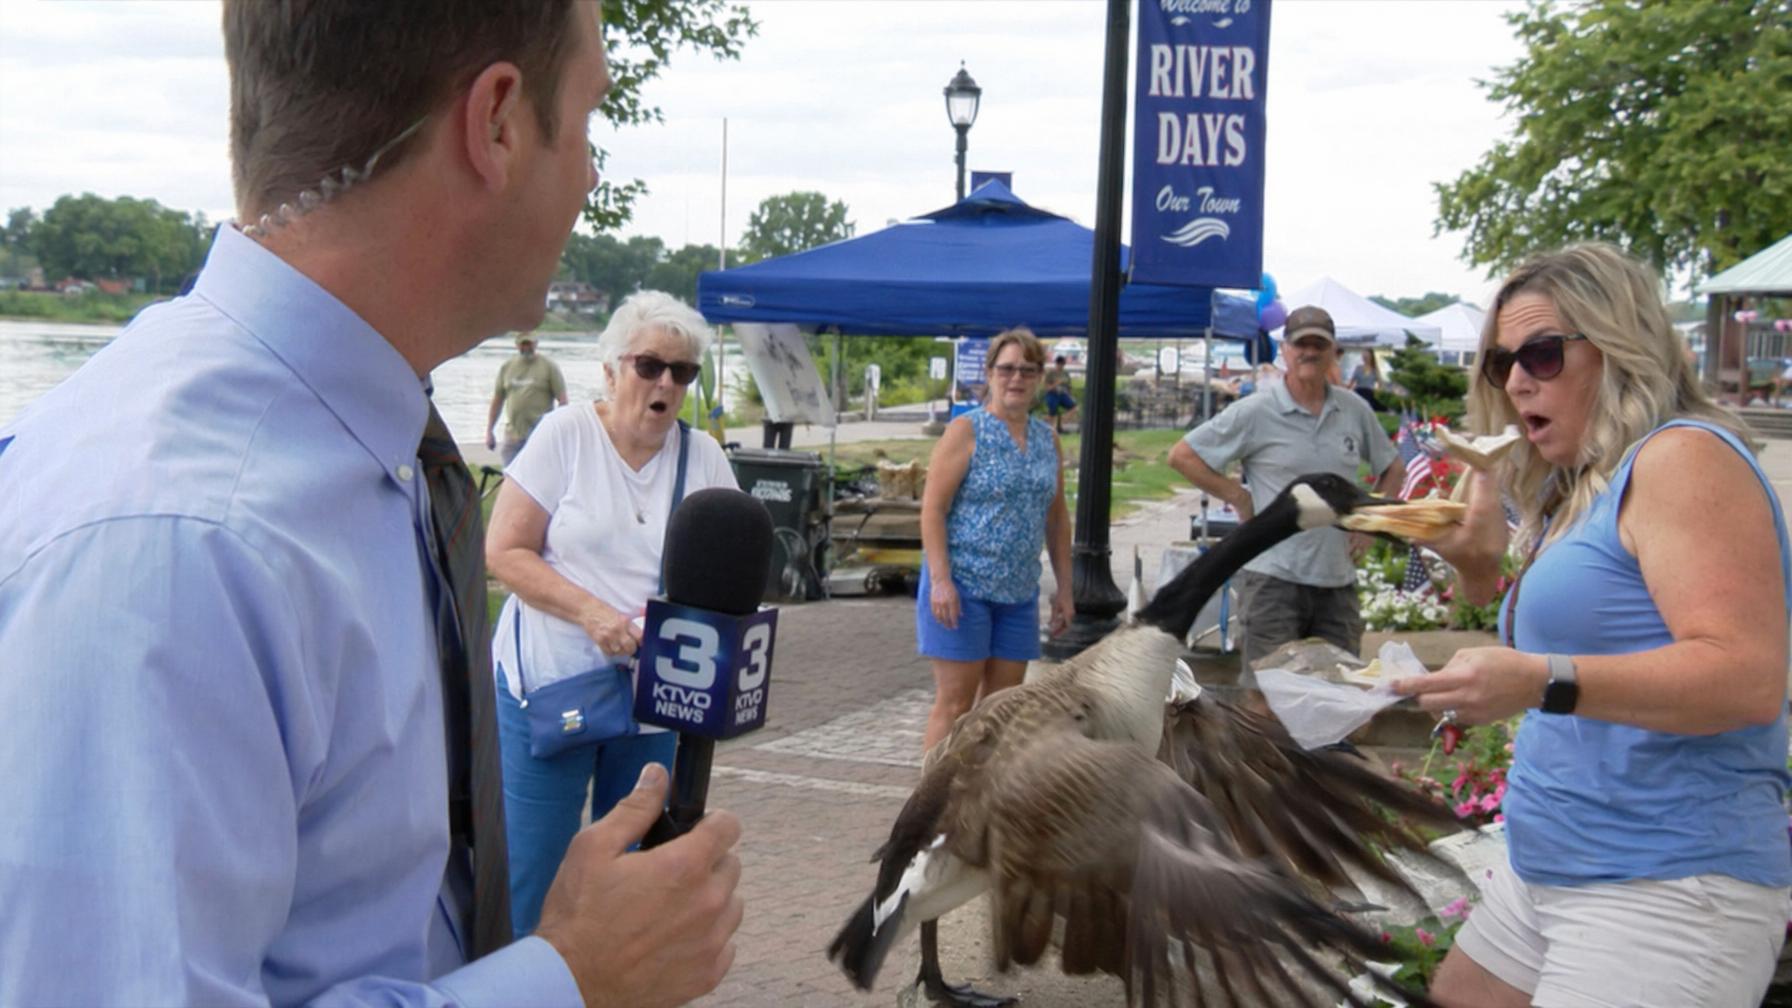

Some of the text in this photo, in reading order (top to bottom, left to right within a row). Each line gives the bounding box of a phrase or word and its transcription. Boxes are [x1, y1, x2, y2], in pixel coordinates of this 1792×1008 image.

[1149, 43, 1256, 100] RIVER
[1156, 111, 1246, 167] DAYS
[1155, 184, 1241, 213] Our Town
[655, 618, 719, 690] 3
[738, 622, 771, 692] 3
[652, 682, 712, 709] KTVO
[735, 688, 763, 711] KTVO
[655, 699, 704, 724] NEWS
[735, 705, 758, 726] NEWS
